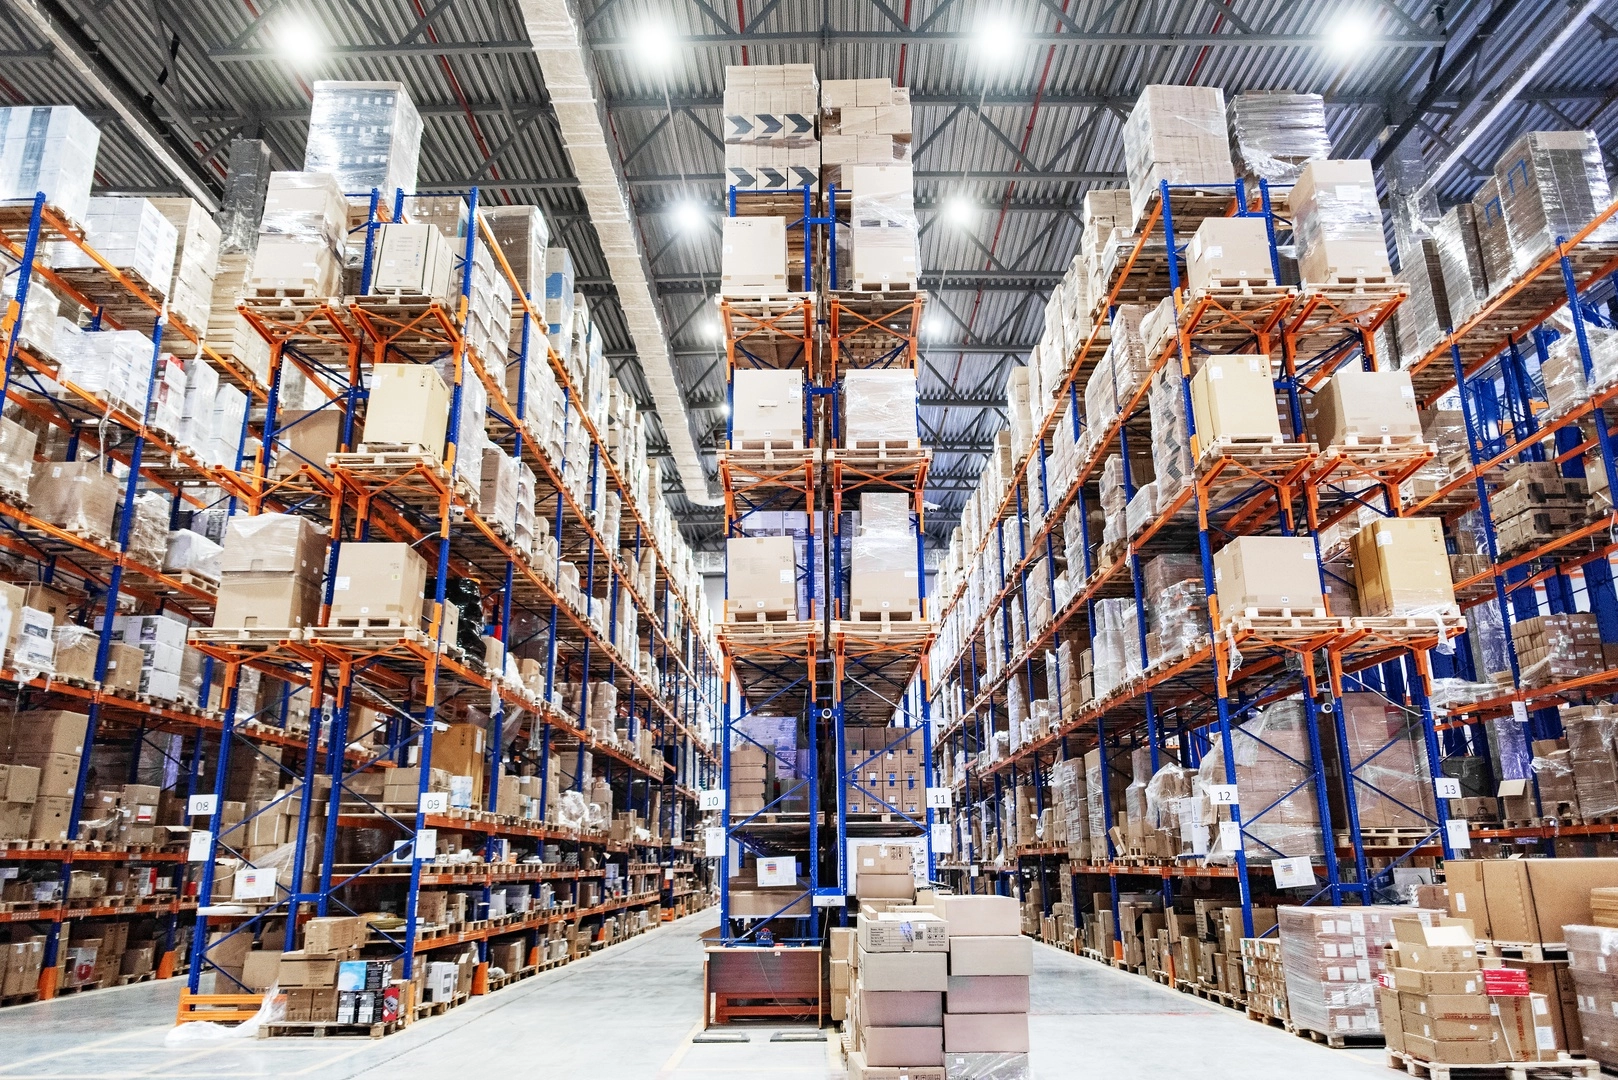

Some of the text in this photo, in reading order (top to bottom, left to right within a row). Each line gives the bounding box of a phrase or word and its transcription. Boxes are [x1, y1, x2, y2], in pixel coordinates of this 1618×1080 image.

[1443, 784, 1457, 795] 13
[706, 796, 719, 807] 10
[934, 794, 947, 805] 11
[1217, 791, 1232, 801] 12
[195, 801, 209, 812] 08
[426, 799, 440, 810] 09
